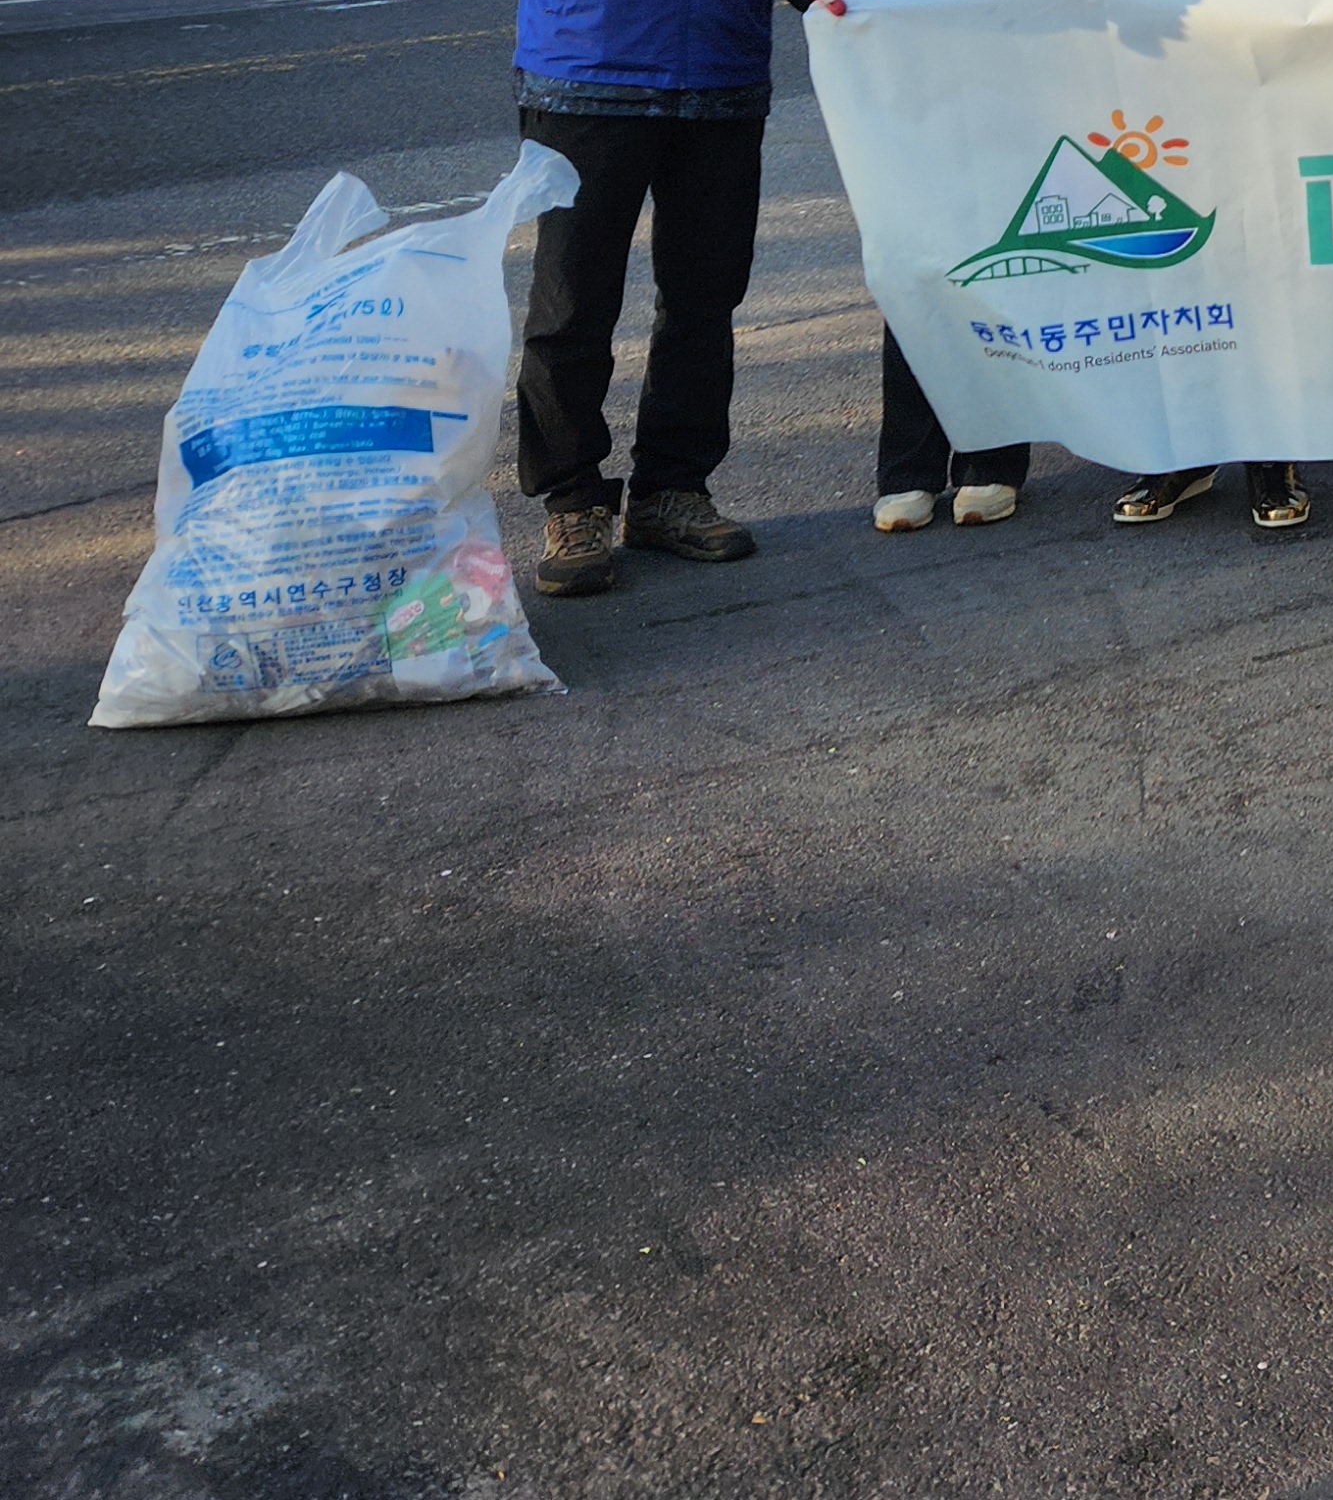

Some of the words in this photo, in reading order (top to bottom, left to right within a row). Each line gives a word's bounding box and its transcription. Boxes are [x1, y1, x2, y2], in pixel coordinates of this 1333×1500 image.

[1048, 359, 1081, 373] dong
[1161, 338, 1238, 358] Association
[178, 566, 408, 613] 인천광역시연수구청장
